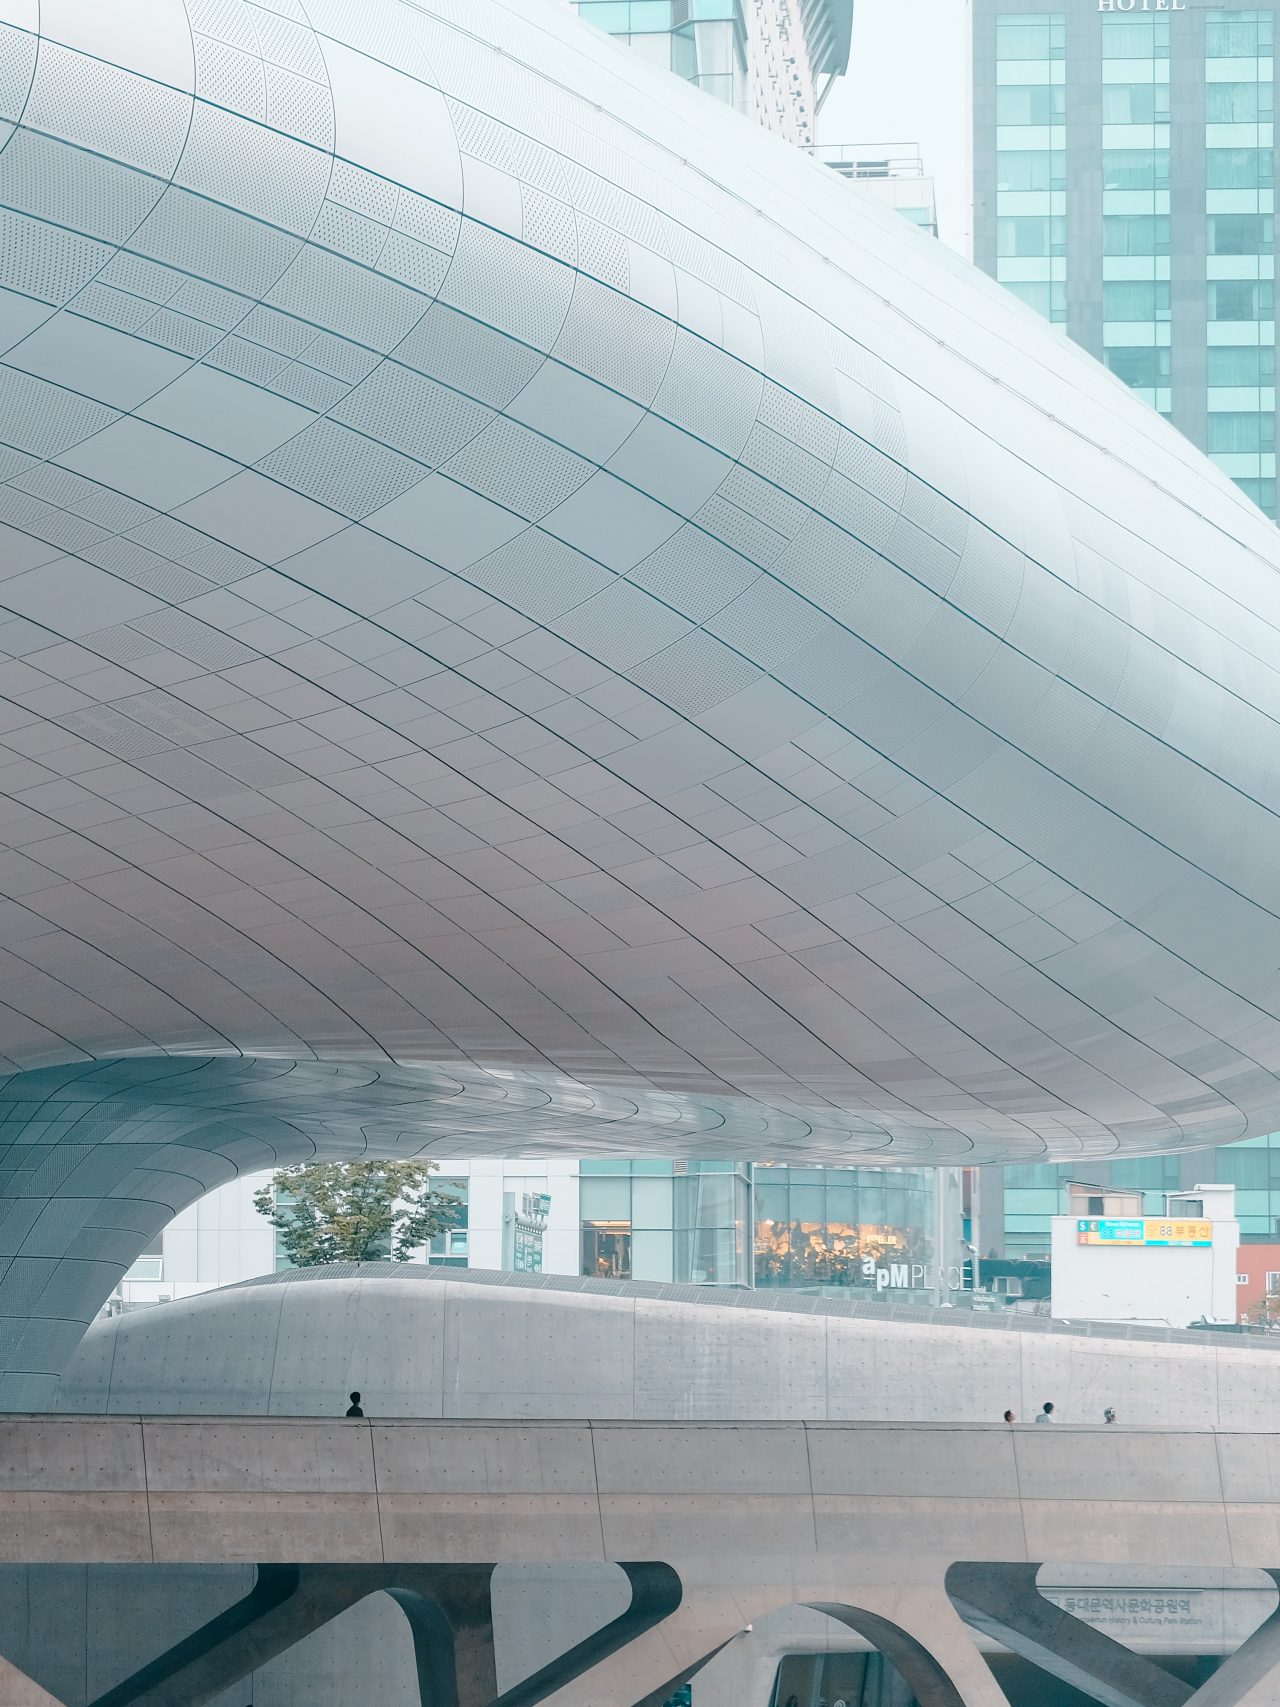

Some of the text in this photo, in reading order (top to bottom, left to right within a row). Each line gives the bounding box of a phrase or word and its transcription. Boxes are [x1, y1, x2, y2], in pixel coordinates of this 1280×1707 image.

[1097, 0, 1185, 11] HOTEL
[1160, 1226, 1172, 1236] 88
[862, 1256, 972, 1291] apM PLACE
[1064, 1598, 1191, 1614] 동대문역사문화공원역
